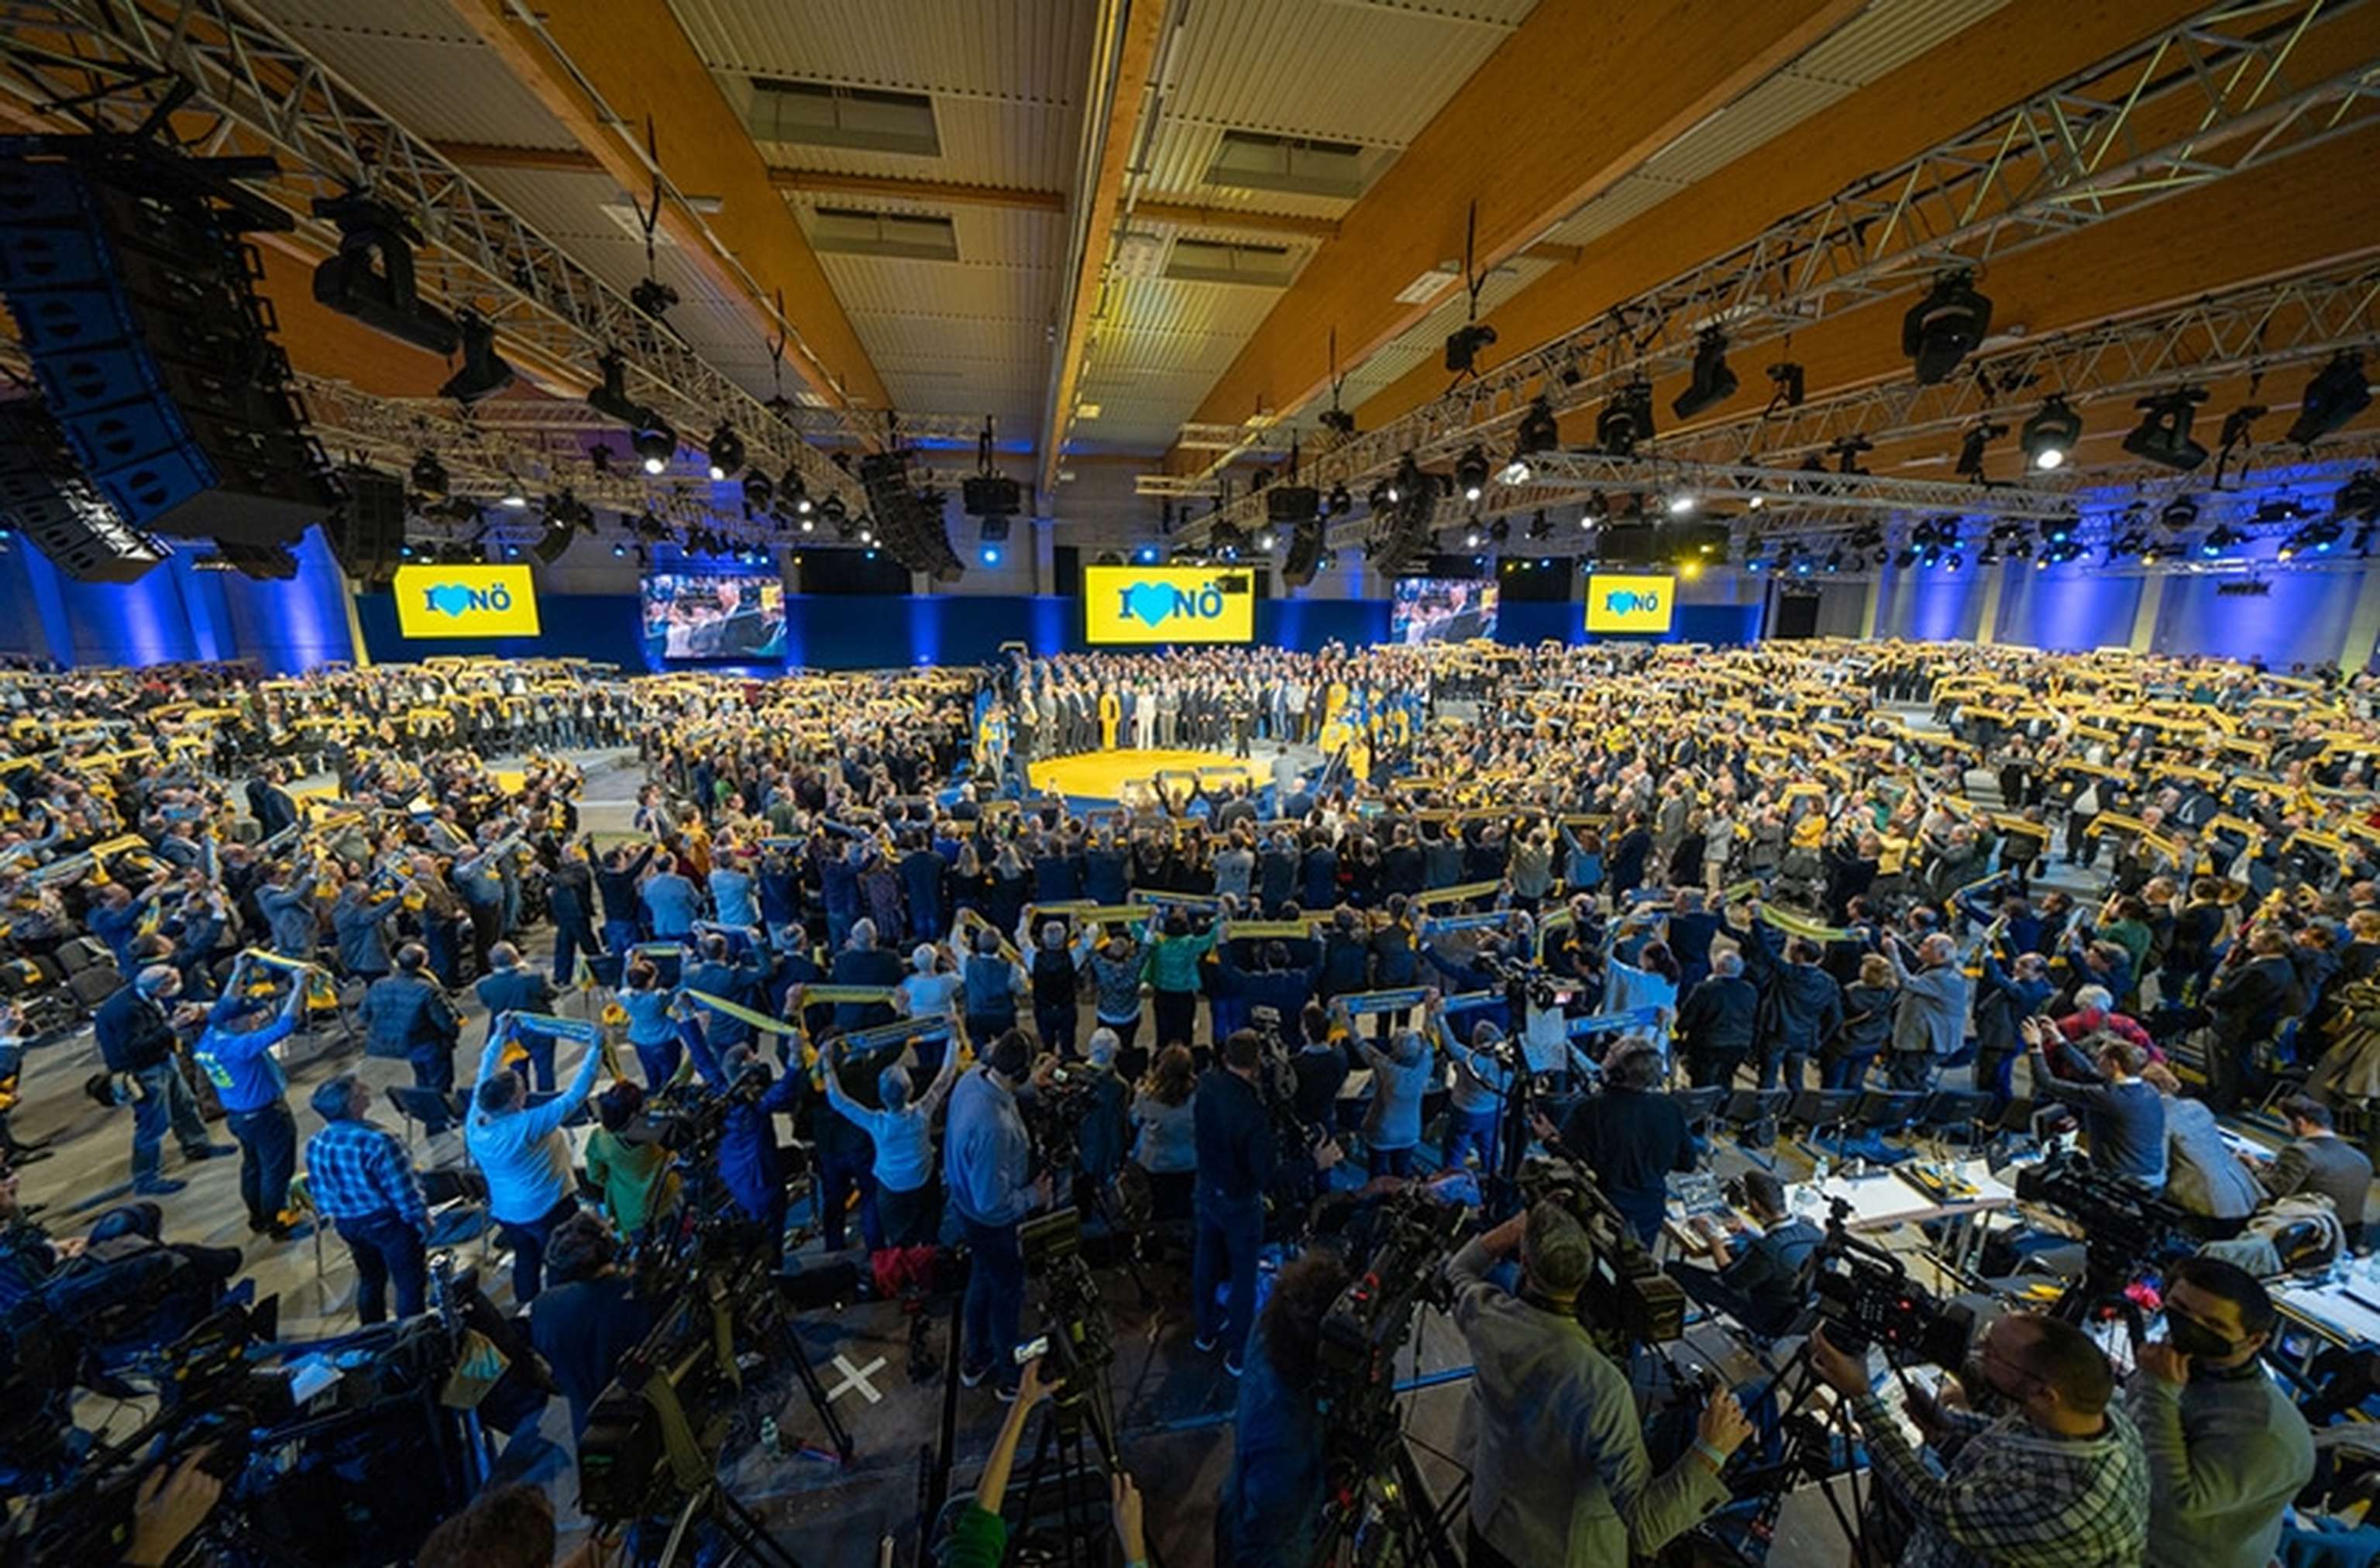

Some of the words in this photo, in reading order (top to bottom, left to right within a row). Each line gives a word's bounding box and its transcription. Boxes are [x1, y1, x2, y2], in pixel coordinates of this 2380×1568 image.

[423, 589, 438, 611] I
[468, 583, 511, 611] NÖ
[1118, 589, 1133, 618] I
[1173, 582, 1223, 618] NÖ
